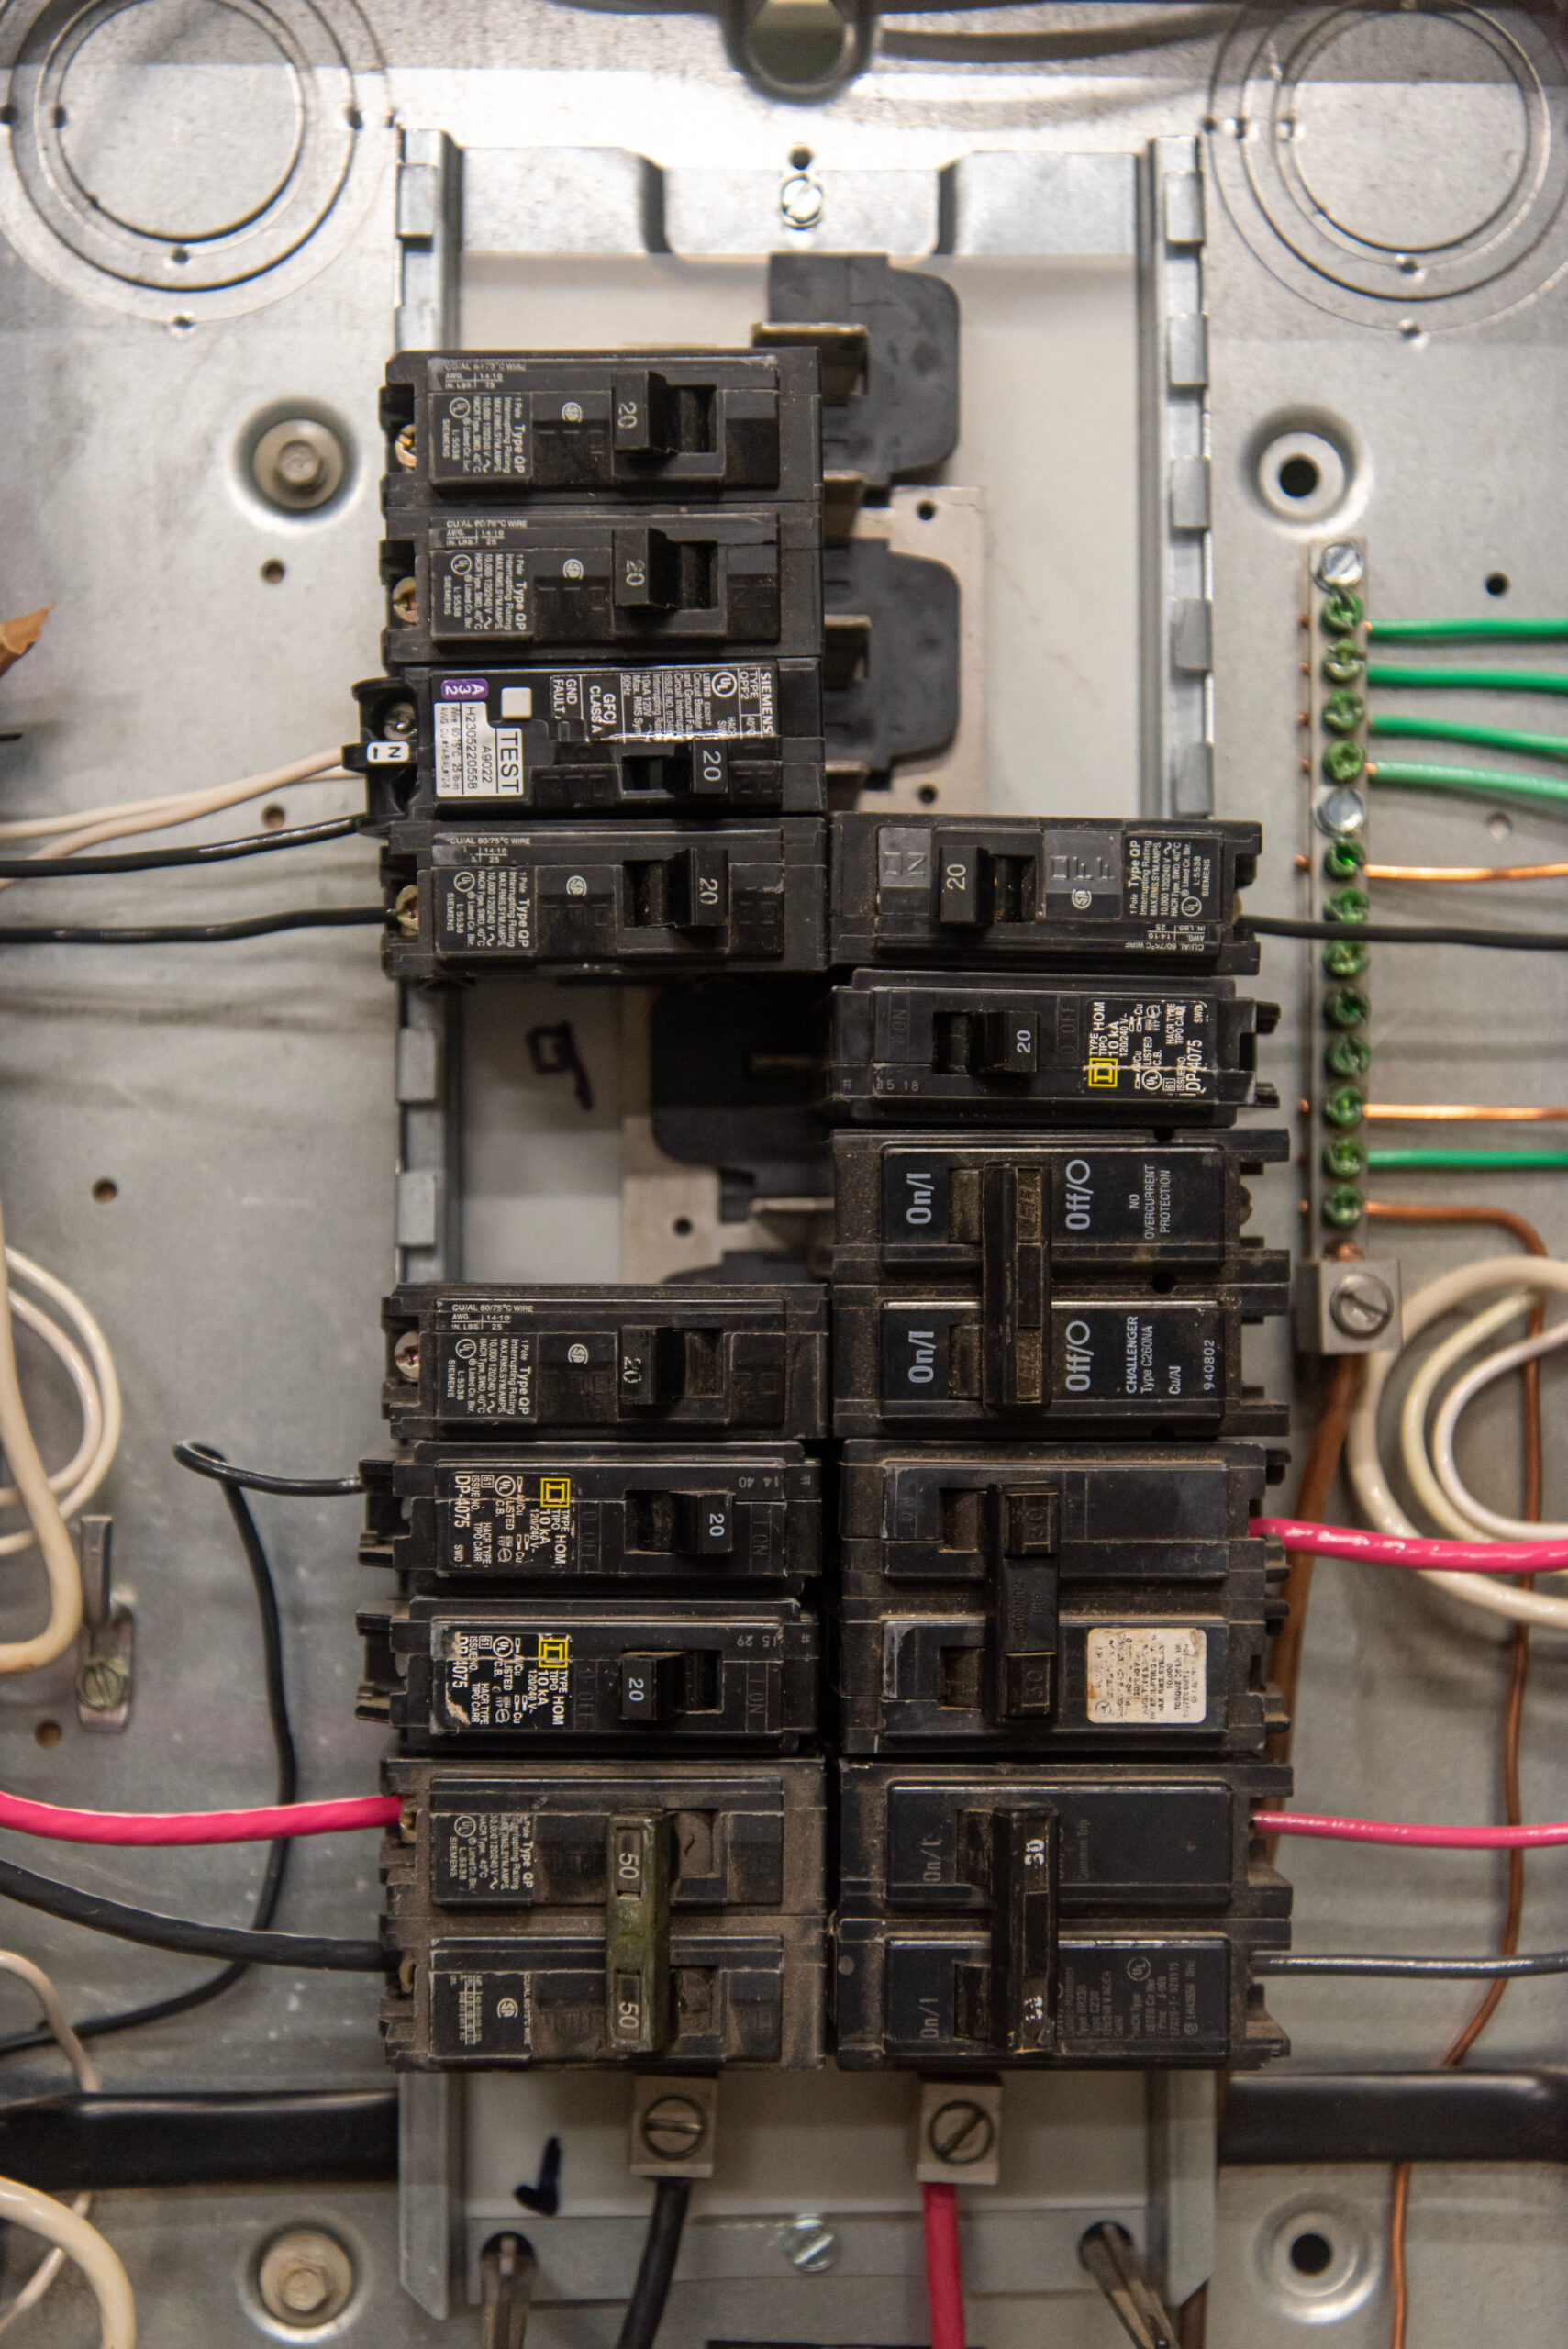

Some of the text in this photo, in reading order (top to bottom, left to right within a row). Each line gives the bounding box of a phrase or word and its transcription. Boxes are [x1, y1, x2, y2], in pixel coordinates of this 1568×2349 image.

[617, 401, 638, 429] 20
[442, 418, 450, 458] SIEMENS
[511, 424, 527, 474] Type QP
[625, 559, 646, 587] 20
[444, 575, 452, 615] SIEMENS
[503, 553, 514, 630] Interrupting Rating
[513, 581, 528, 631] Type QP
[552, 678, 565, 714] FAULT
[565, 678, 576, 705] GND
[623, 674, 631, 696] 60Hz
[642, 674, 652, 717] 10kA 120V
[652, 674, 662, 715] Interrupting
[664, 673, 673, 695] ISSUE
[674, 673, 684, 698] Circuit
[684, 673, 694, 720] and Ground
[740, 671, 749, 700] QPF2
[749, 671, 759, 698] TYPE
[589, 685, 602, 734] CLASS A
[602, 693, 616, 725] GFCI
[634, 696, 642, 716] RMS
[694, 672, 703, 729] Circuit Breaker
[761, 672, 773, 734] SIEMENS
[465, 707, 478, 790] H2305220558
[500, 731, 519, 793] TEST
[481, 745, 493, 784] A9022
[702, 750, 722, 782] 20
[477, 871, 485, 890] HACR
[946, 863, 966, 891] 20
[1128, 840, 1142, 909] Pole Type QP
[1139, 840, 1152, 916] Interrupting Rating
[1202, 858, 1211, 896] SIEMENS
[699, 877, 718, 905] 20
[447, 892, 455, 931] SIEMENS
[506, 872, 517, 948] Interrupting Rating
[517, 877, 530, 948] Pole Type QP
[1171, 898, 1179, 917] HACR
[1134, 1003, 1143, 1015] Cu
[1194, 1005, 1204, 1024] SWD
[1016, 1029, 1031, 1054] 20
[1089, 1001, 1106, 1055] TYPE HOM
[1108, 1020, 1119, 1057] 10 kA
[1120, 1026, 1129, 1057] 120/240
[1166, 1023, 1174, 1044] HACR
[1174, 1028, 1184, 1044] TIPO
[1099, 1035, 1108, 1055] TIPO
[1143, 1036, 1152, 1065] LISTED
[1153, 1049, 1162, 1065] C.B.
[904, 1080, 919, 1091] 18
[1176, 1070, 1185, 1092] ISSUE
[1129, 1194, 1140, 1209] NO
[1144, 1164, 1155, 1239] OVERCURRENT
[1159, 1169, 1171, 1234] PROTECTION
[479, 1338, 487, 1357] HACR
[489, 1338, 498, 1362] 10,000
[1126, 1316, 1138, 1395] CHALLENGER
[1140, 1325, 1155, 1394] Type C260NA
[447, 1359, 456, 1398] SIEMENS
[468, 1367, 476, 1386] Listed
[506, 1338, 519, 1415] Interrupting Rating
[517, 1344, 531, 1415] Pole Type QP
[622, 1355, 642, 1384] 20
[1168, 1365, 1182, 1395] Cu/Al
[1203, 1339, 1216, 1391] 940802
[454, 1475, 471, 1528] DP-4075
[471, 1475, 480, 1512] ISSUE NO.
[495, 1499, 505, 1518] C.B.
[505, 1500, 515, 1531] LISTED
[529, 1508, 539, 1541] 120/240
[539, 1509, 551, 1545] 10 kA
[550, 1509, 561, 1531] TIPO
[708, 1512, 725, 1537] 20
[473, 1522, 483, 1562] TIPO CARR
[482, 1522, 492, 1564] HACR TYPE
[554, 1509, 570, 1564] TYPE HOM
[453, 1543, 463, 1563] SWD
[515, 1551, 525, 1563] Cu
[468, 1636, 478, 1658] ISSUE
[494, 1660, 503, 1678] C.B.
[549, 1670, 558, 1691] TIPO
[528, 1670, 537, 1701] 120/240
[537, 1669, 550, 1707] 10 kA
[551, 1670, 568, 1725] TYPE HOM
[628, 1677, 644, 1702] 20
[471, 1683, 481, 1724] TIPO CARR
[479, 1683, 490, 1725] HACR TYPE
[513, 1711, 523, 1725] Cu
[1077, 1820, 1092, 1837] Trip
[450, 1836, 458, 1877] SIEMENS
[459, 1846, 467, 1880] L-5538
[520, 1841, 534, 1888] Type QP
[618, 1852, 640, 1879] 50
[1024, 1838, 1045, 1866] 30
[510, 1864, 521, 1890] Rating
[618, 2000, 640, 2029] 50
